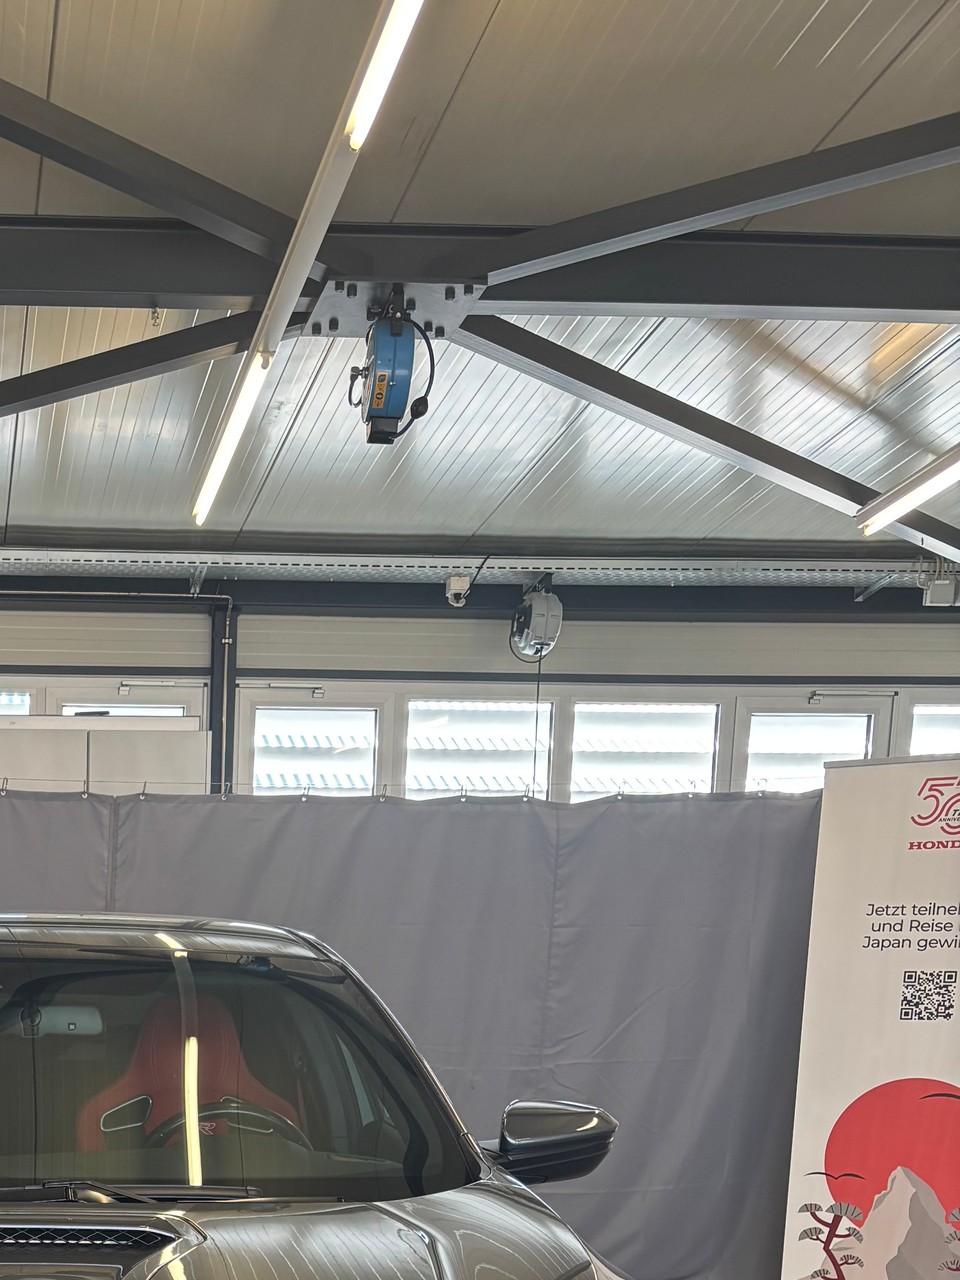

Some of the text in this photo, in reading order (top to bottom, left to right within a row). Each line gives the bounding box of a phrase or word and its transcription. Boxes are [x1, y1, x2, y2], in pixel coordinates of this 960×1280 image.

[866, 902, 960, 916] Jetzt teilne
[871, 919, 903, 932] und
[909, 919, 954, 932] Reise
[862, 935, 960, 951] Japan gewi
